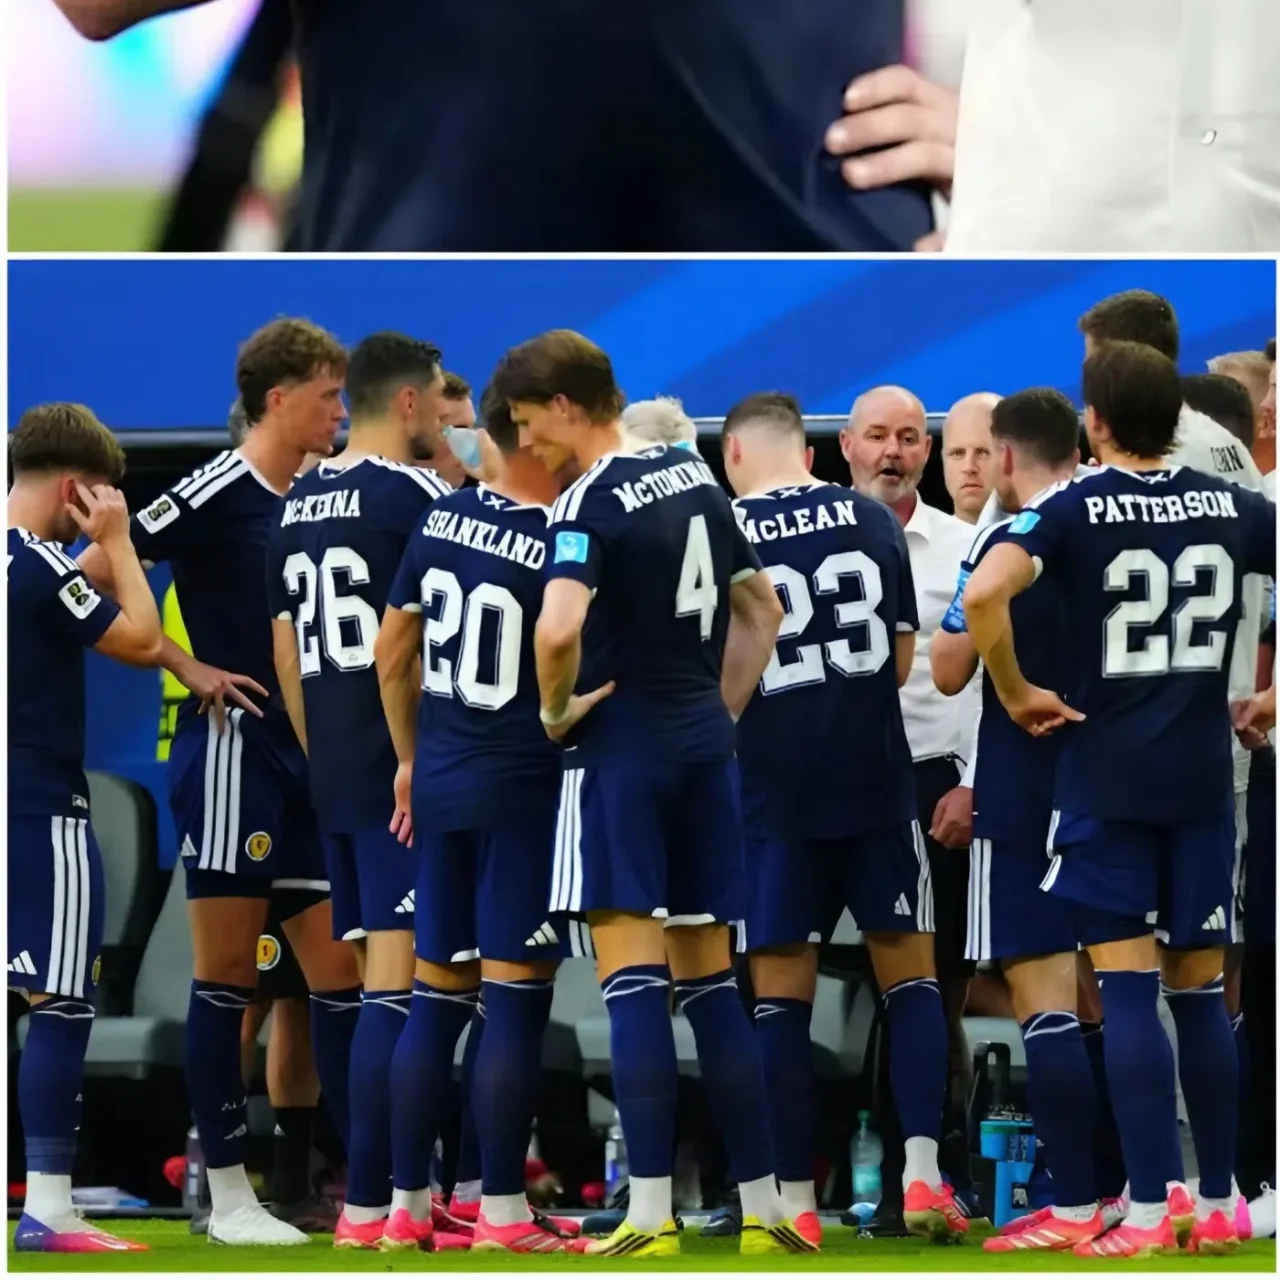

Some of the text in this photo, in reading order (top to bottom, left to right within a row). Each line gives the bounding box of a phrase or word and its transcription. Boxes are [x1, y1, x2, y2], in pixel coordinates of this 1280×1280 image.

[422, 509, 546, 570] SHANKLAND
[1085, 491, 1238, 524] PATTERSON
[282, 547, 380, 679] 26
[420, 567, 523, 711] 20
[675, 514, 718, 642] 4
[759, 550, 890, 696] 23
[1102, 544, 1234, 678] 22
